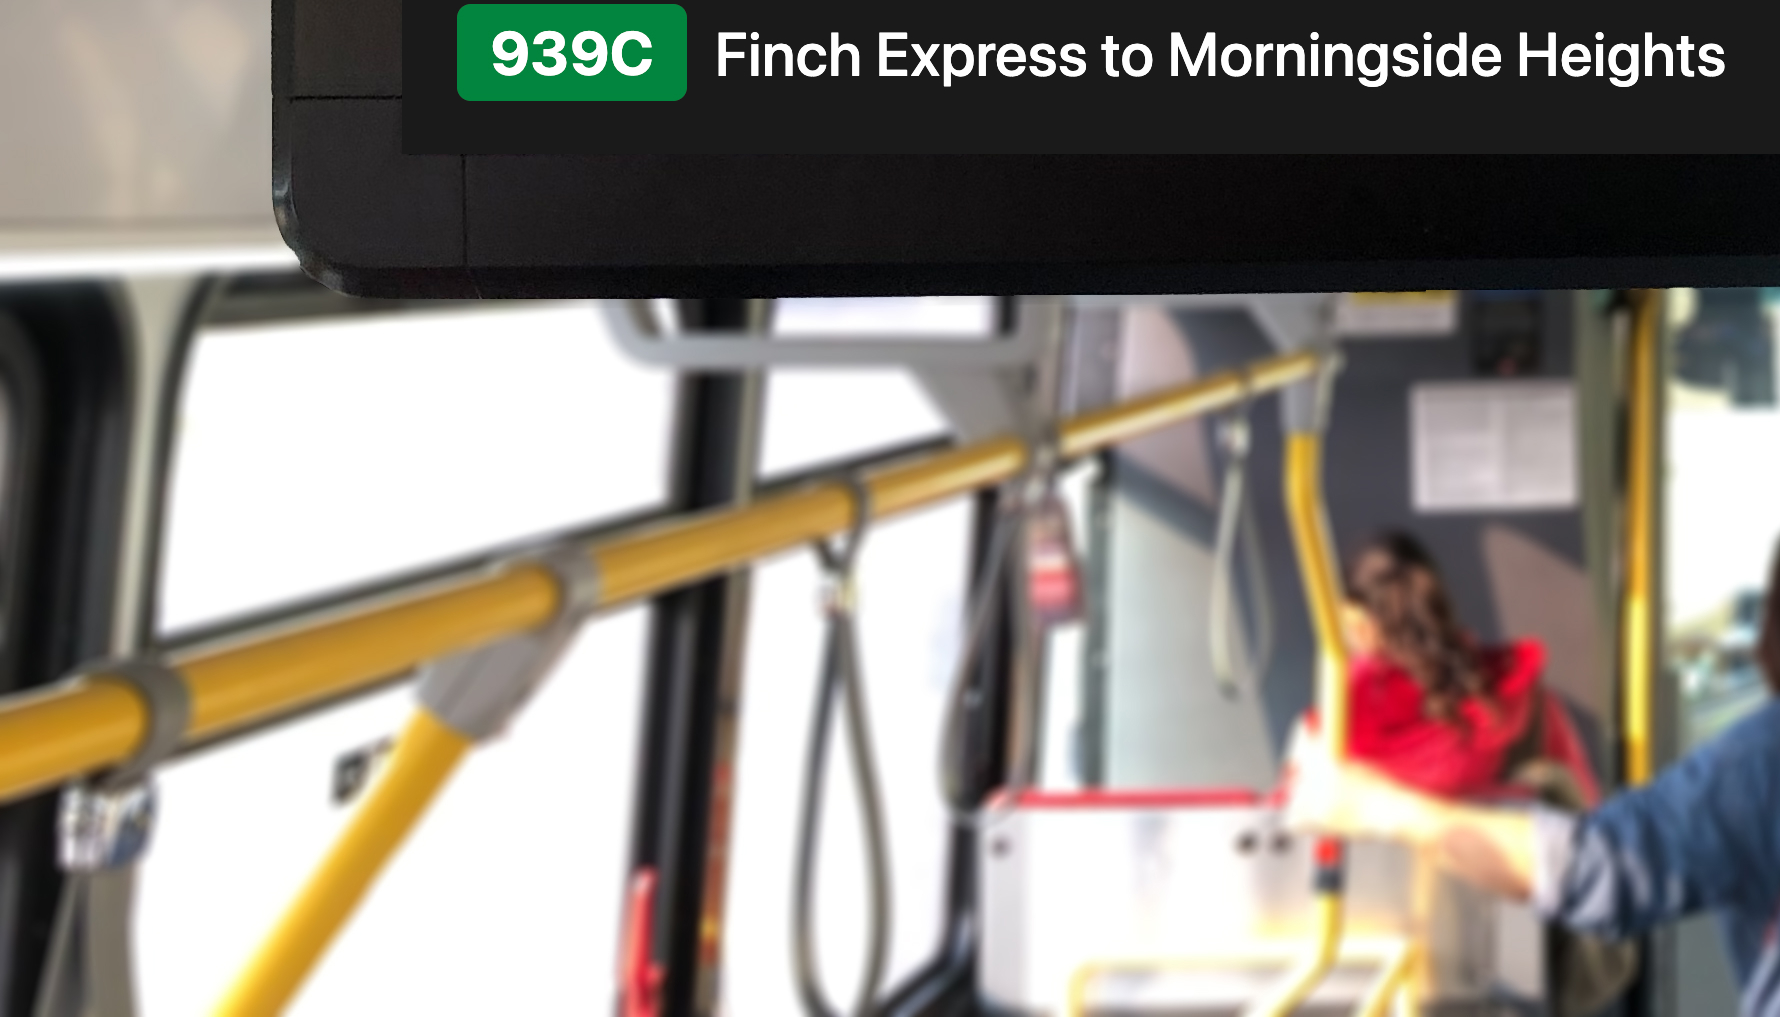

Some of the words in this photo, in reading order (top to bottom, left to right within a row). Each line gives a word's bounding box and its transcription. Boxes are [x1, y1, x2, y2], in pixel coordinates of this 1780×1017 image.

[493, 31, 652, 76] 939C
[718, 32, 859, 77] Finch
[879, 32, 1086, 87] Express
[1101, 36, 1153, 77] to
[1171, 32, 1501, 87] Morningside
[1520, 32, 1725, 87] Heights
